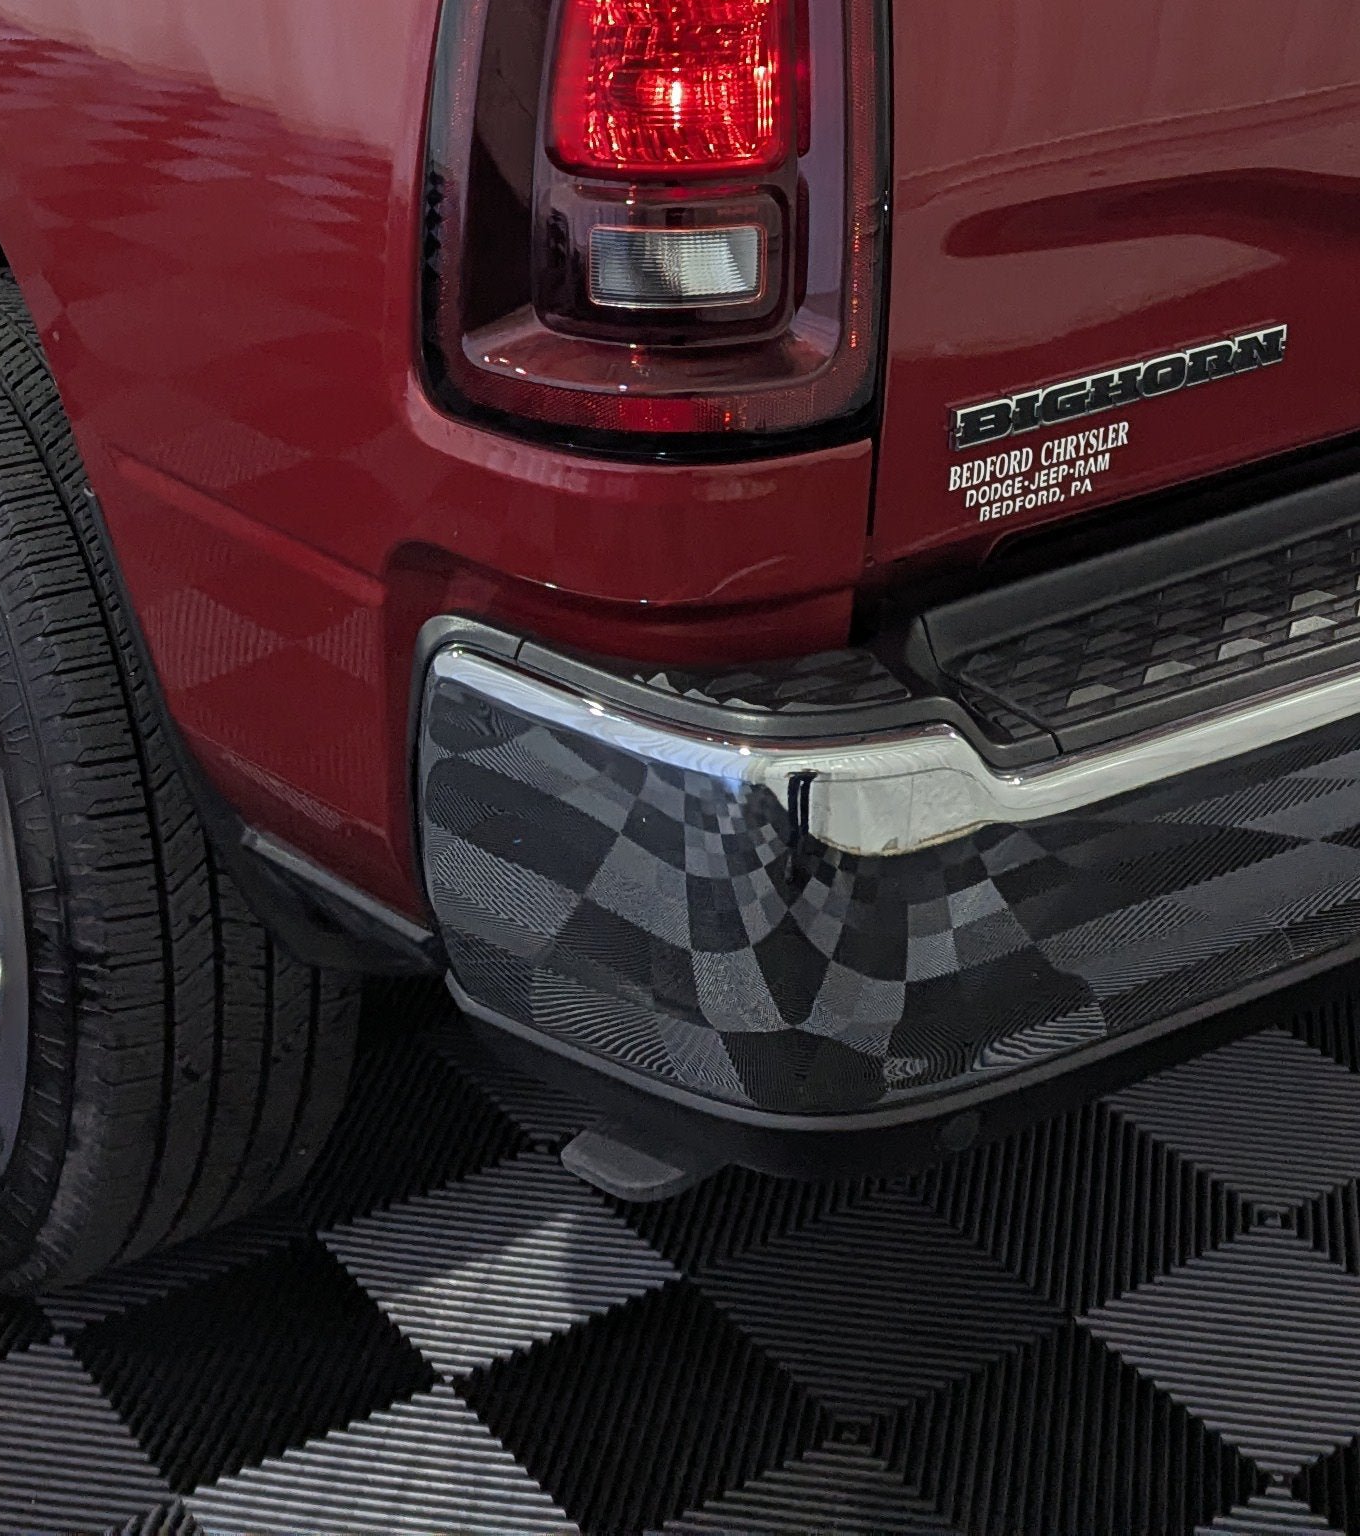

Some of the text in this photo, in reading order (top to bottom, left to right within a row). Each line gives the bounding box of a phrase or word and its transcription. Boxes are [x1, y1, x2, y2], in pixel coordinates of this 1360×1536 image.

[948, 323, 1288, 451] BIGHORN
[948, 421, 1129, 491] BEDFORD CHRYSLER
[979, 478, 1093, 522] BEDFORD, PA
